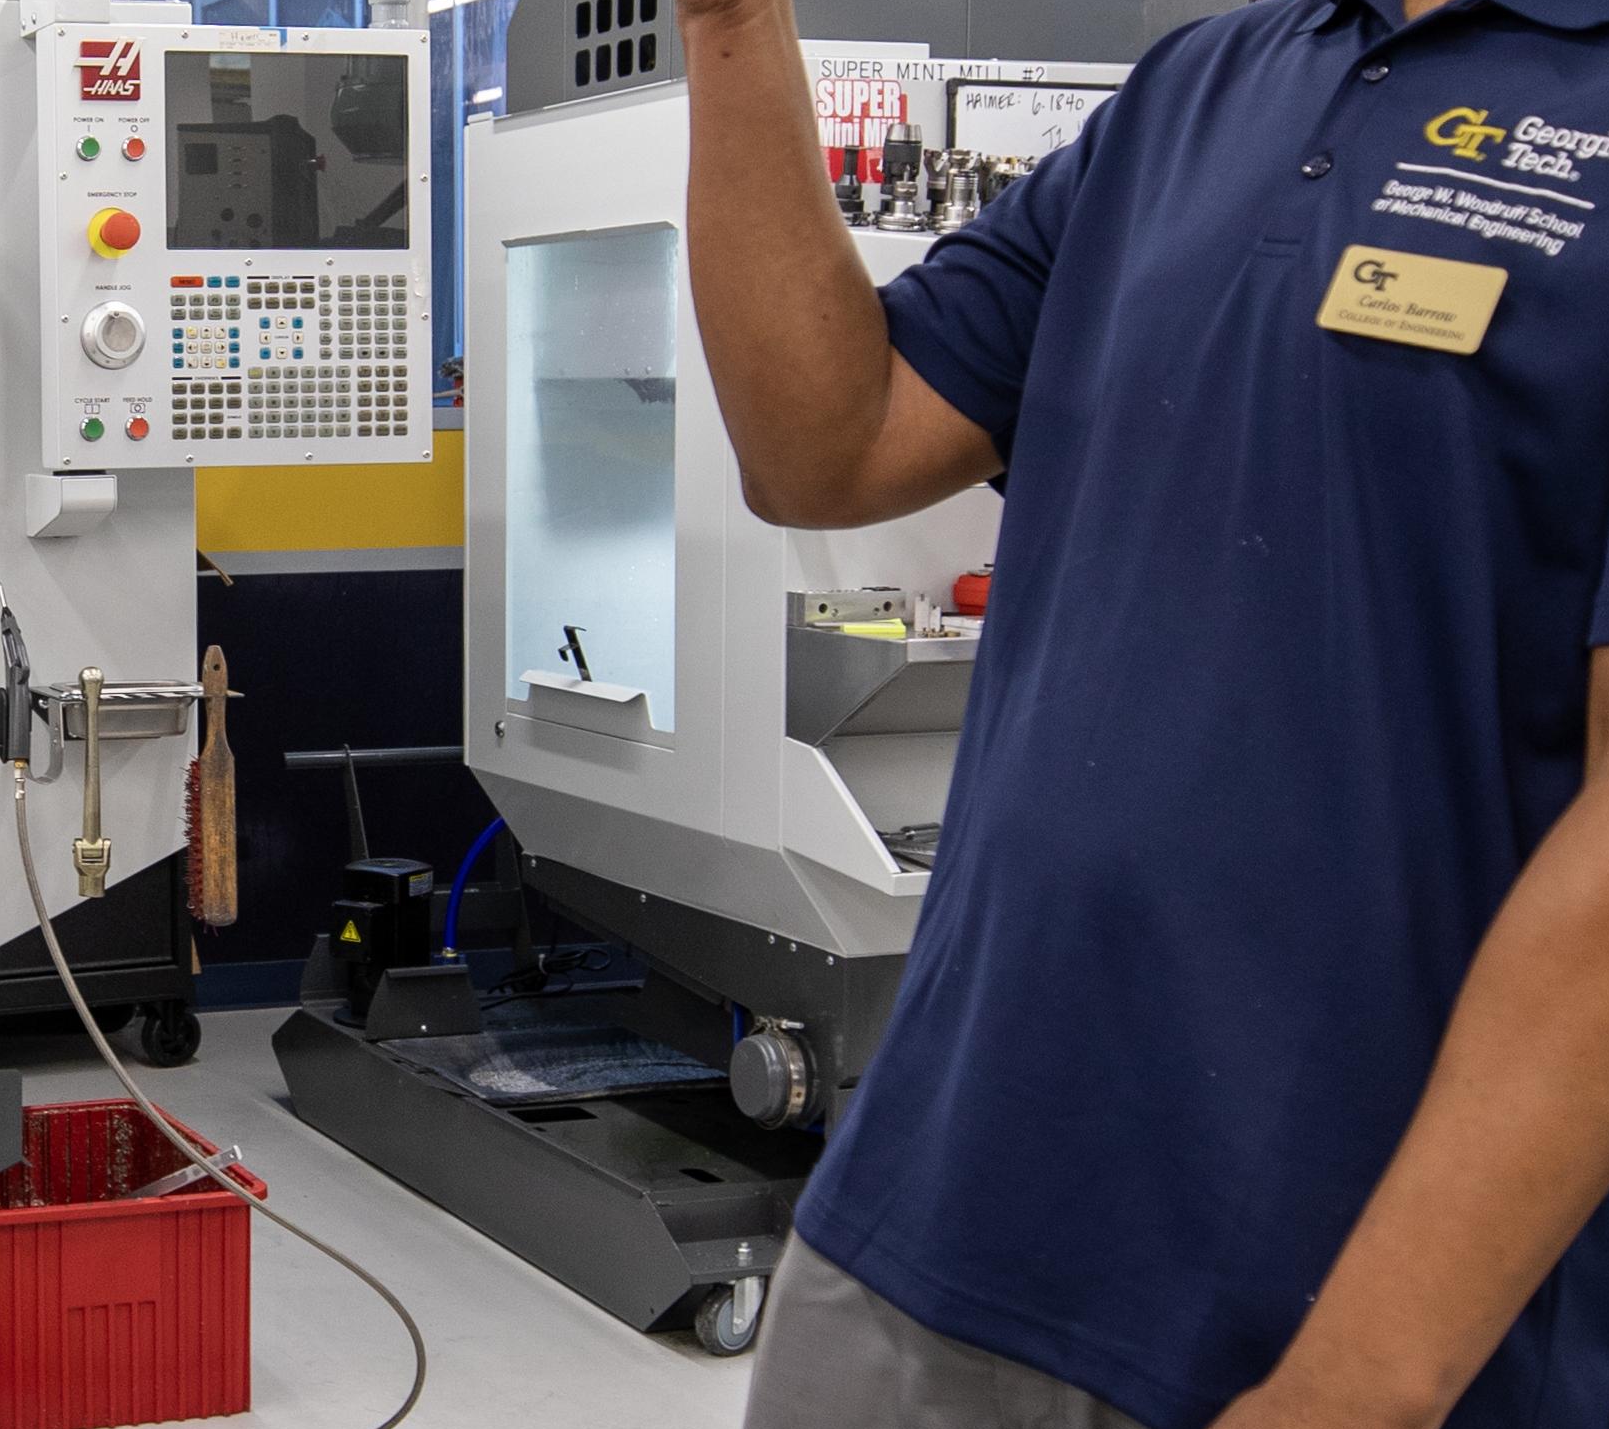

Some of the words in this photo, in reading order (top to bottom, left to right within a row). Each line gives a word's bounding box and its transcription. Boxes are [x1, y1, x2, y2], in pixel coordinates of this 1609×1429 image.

[821, 60, 883, 79] SUPER
[897, 63, 945, 81] MINI
[83, 79, 141, 95] HAAS
[816, 79, 902, 118] SUPER
[966, 92, 1022, 110] HAIMER:
[817, 117, 860, 147] Mini
[1384, 179, 1434, 202] George
[1455, 190, 1528, 221] Woodruff
[1526, 207, 1586, 239] School
[1390, 200, 1469, 227] Mechanical
[1467, 213, 1566, 256] Engineering
[1359, 295, 1401, 313] Carlos
[1406, 303, 1457, 323] Barrow
[1338, 309, 1381, 326] COLLEGE
[1399, 321, 1465, 342] ENGINEERING
